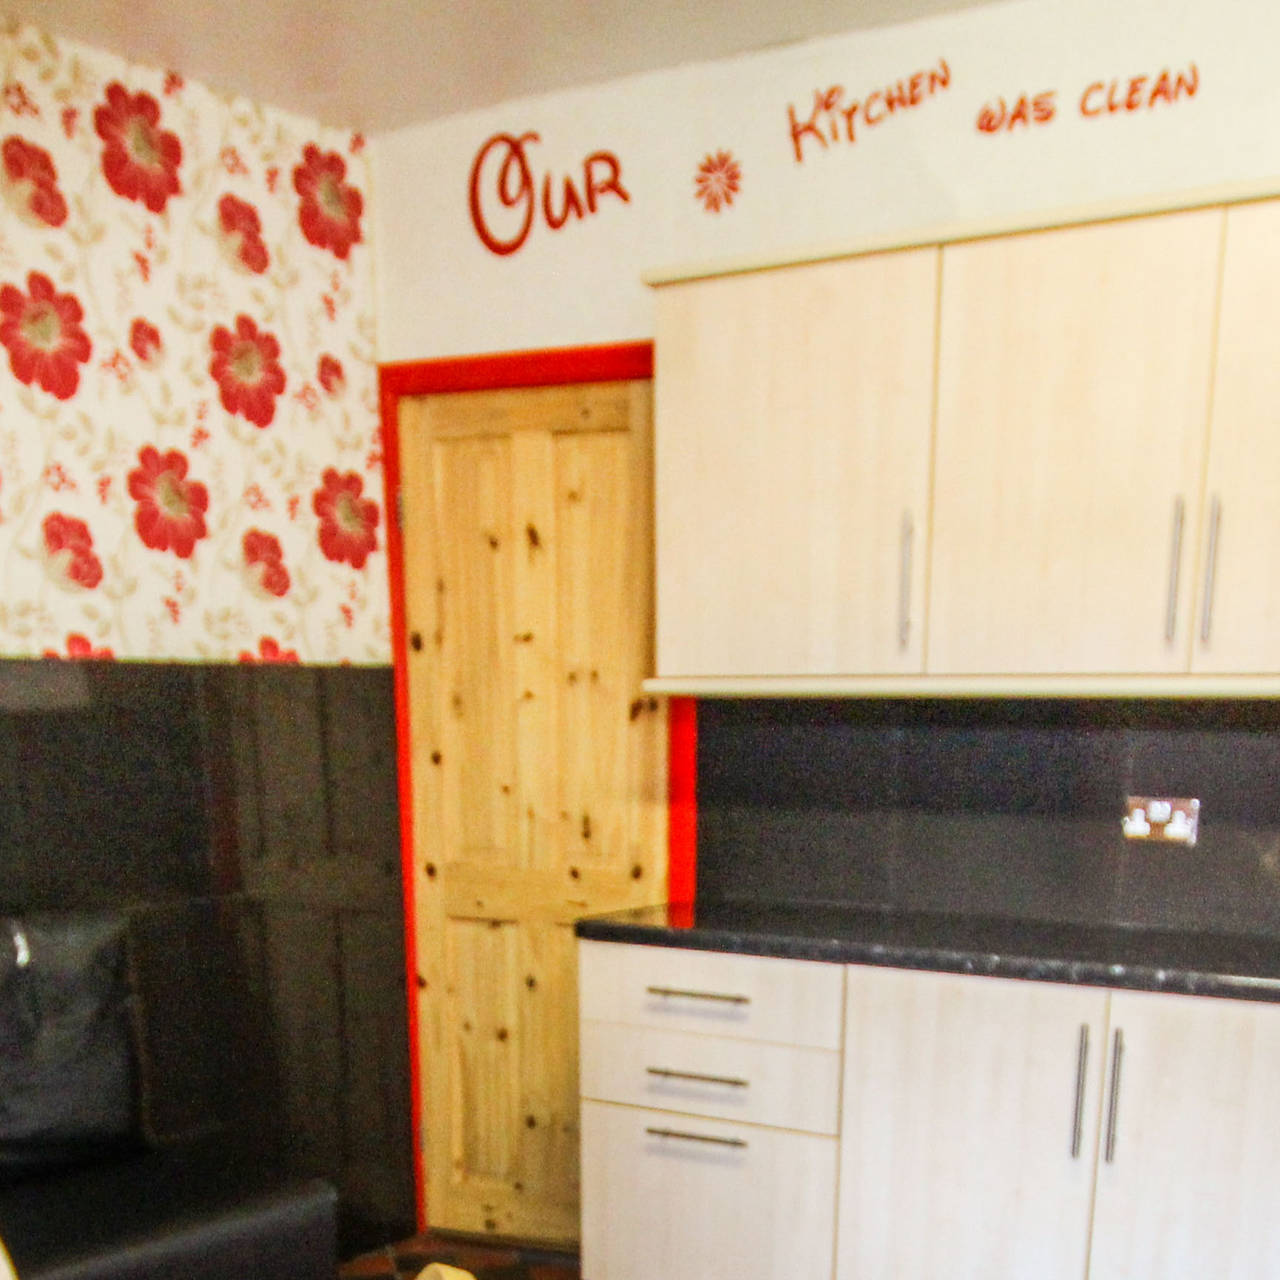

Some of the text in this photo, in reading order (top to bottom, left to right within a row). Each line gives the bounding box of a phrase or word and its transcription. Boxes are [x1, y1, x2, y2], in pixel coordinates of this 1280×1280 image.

[467, 131, 631, 259] OUR
[976, 90, 1056, 133] WAS
[1078, 62, 1198, 116] CLEAN
